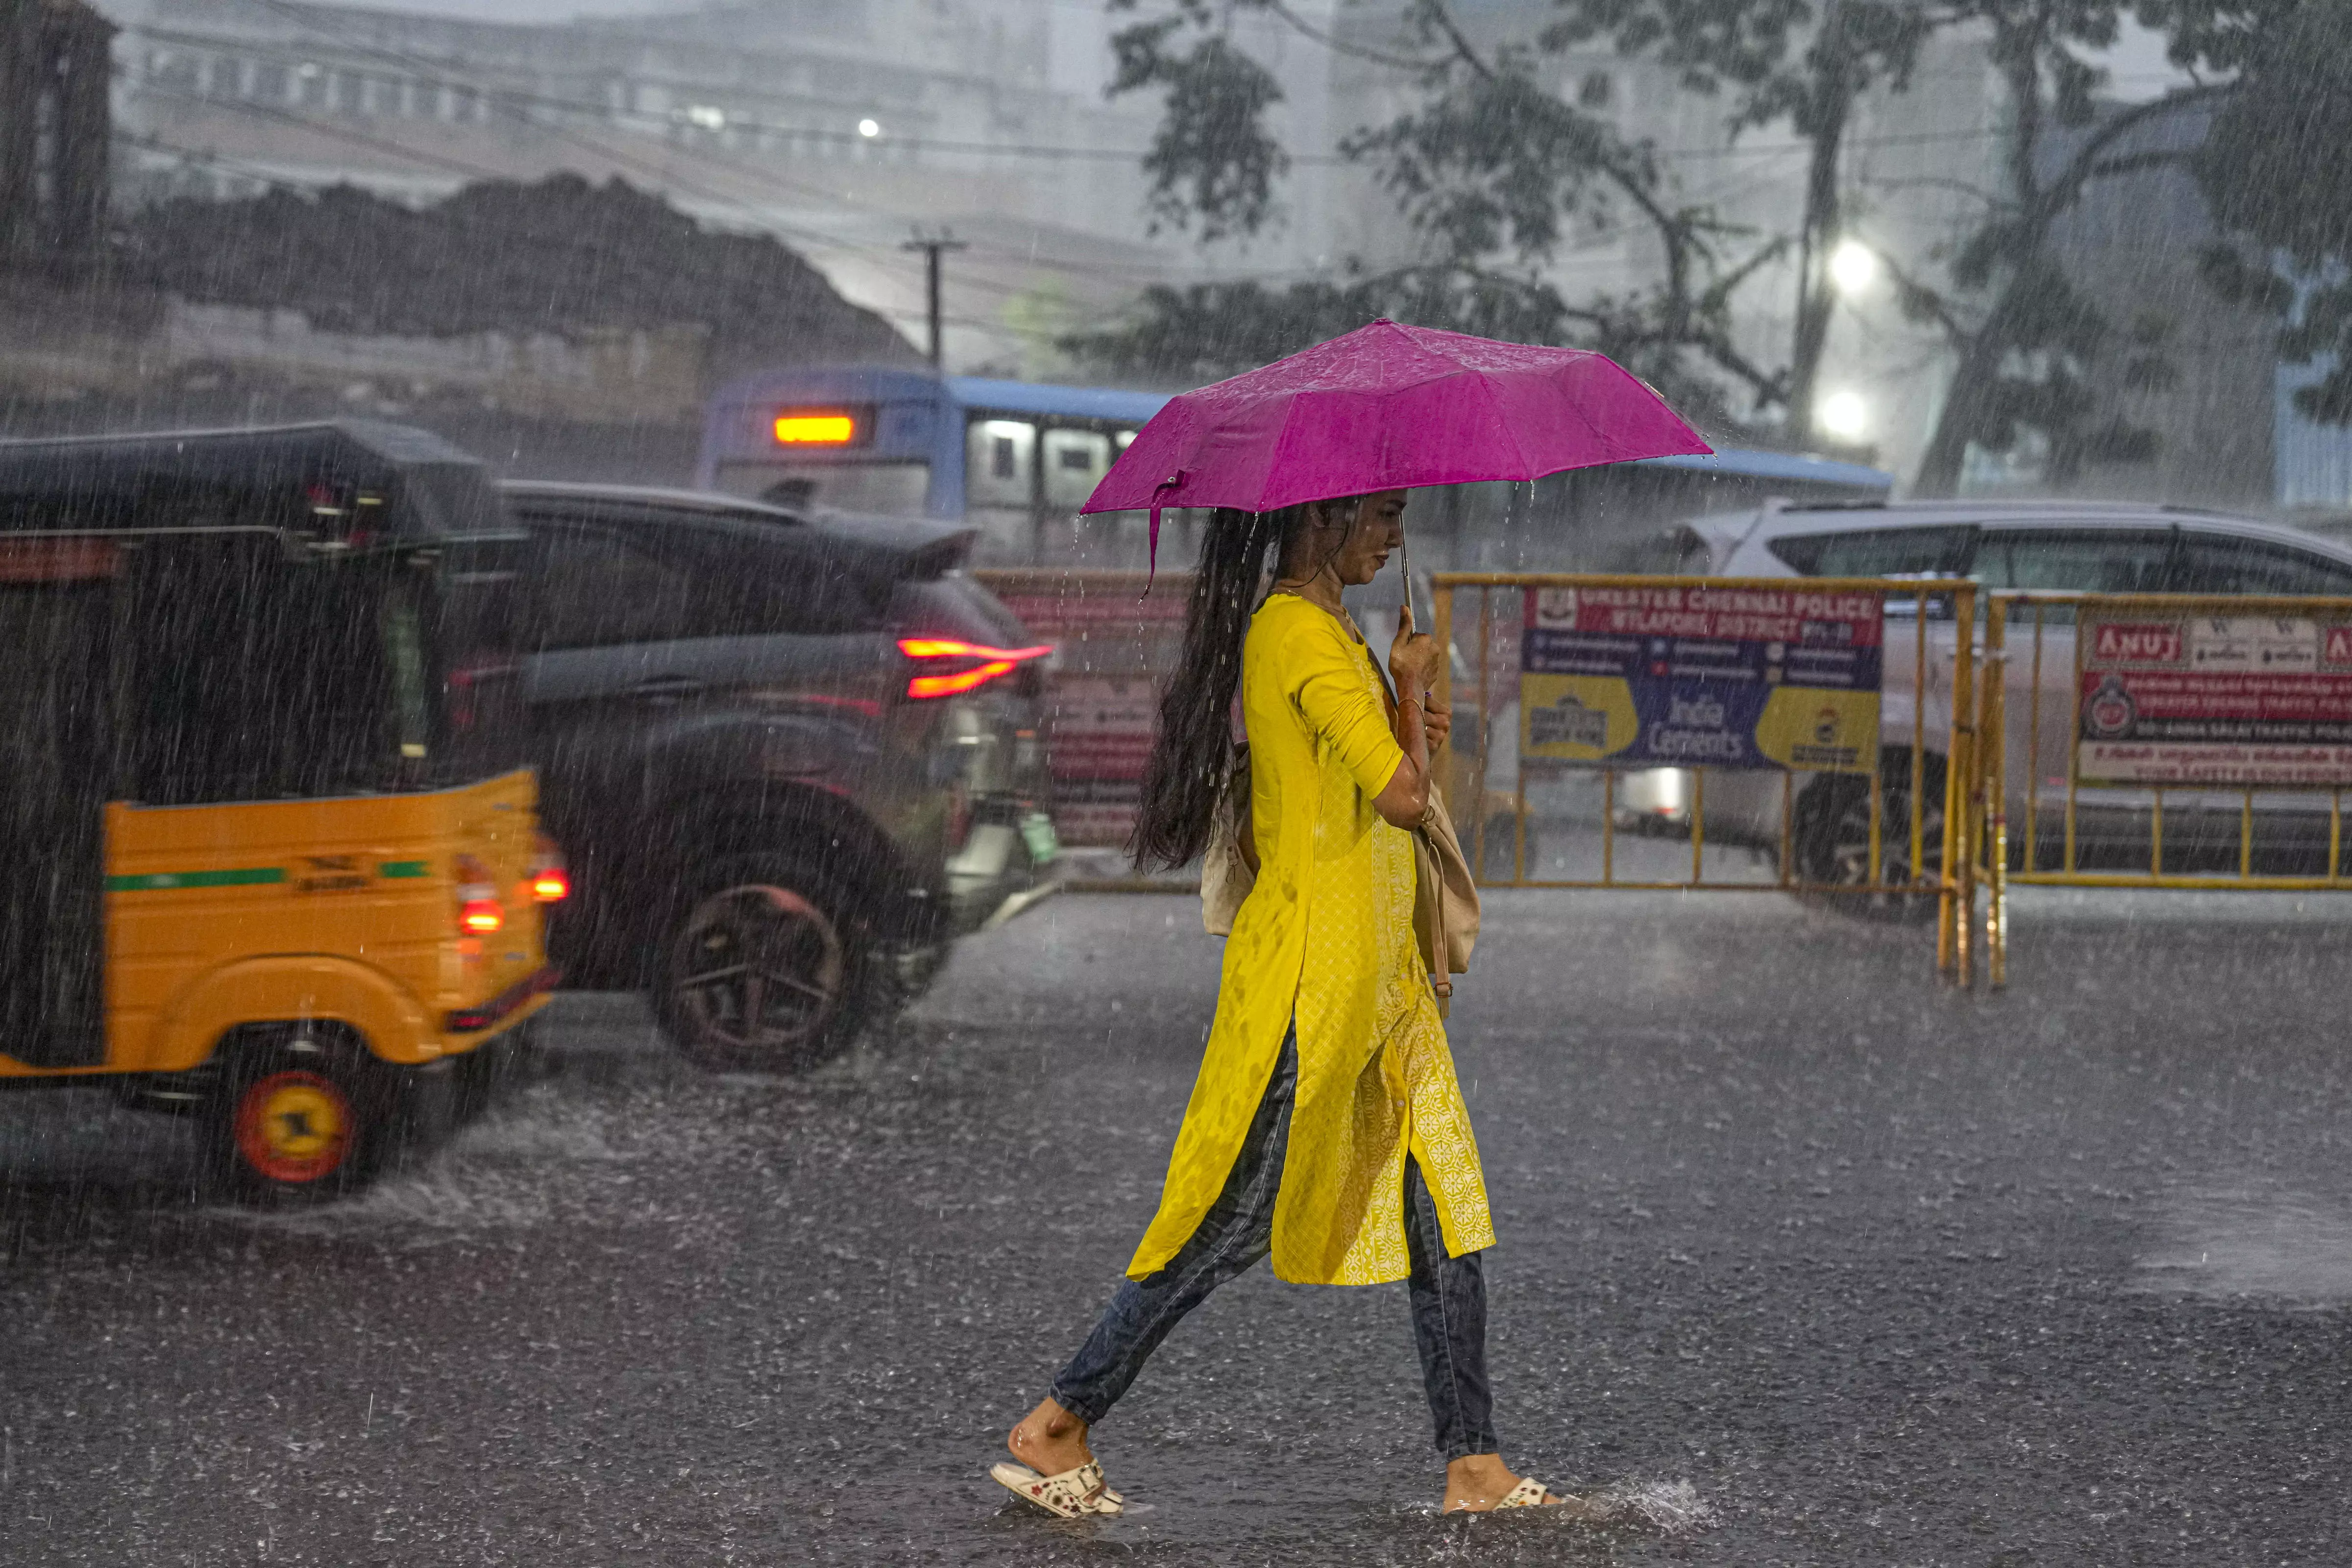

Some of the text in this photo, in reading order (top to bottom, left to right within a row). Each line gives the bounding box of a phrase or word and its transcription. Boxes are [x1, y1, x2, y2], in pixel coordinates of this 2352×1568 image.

[1688, 590, 1788, 614] CHENNAI
[1794, 594, 1873, 619] POLICE
[2099, 628, 2178, 662] ANUJ
[1669, 694, 1725, 727] India
[1648, 721, 1743, 759] Cements
